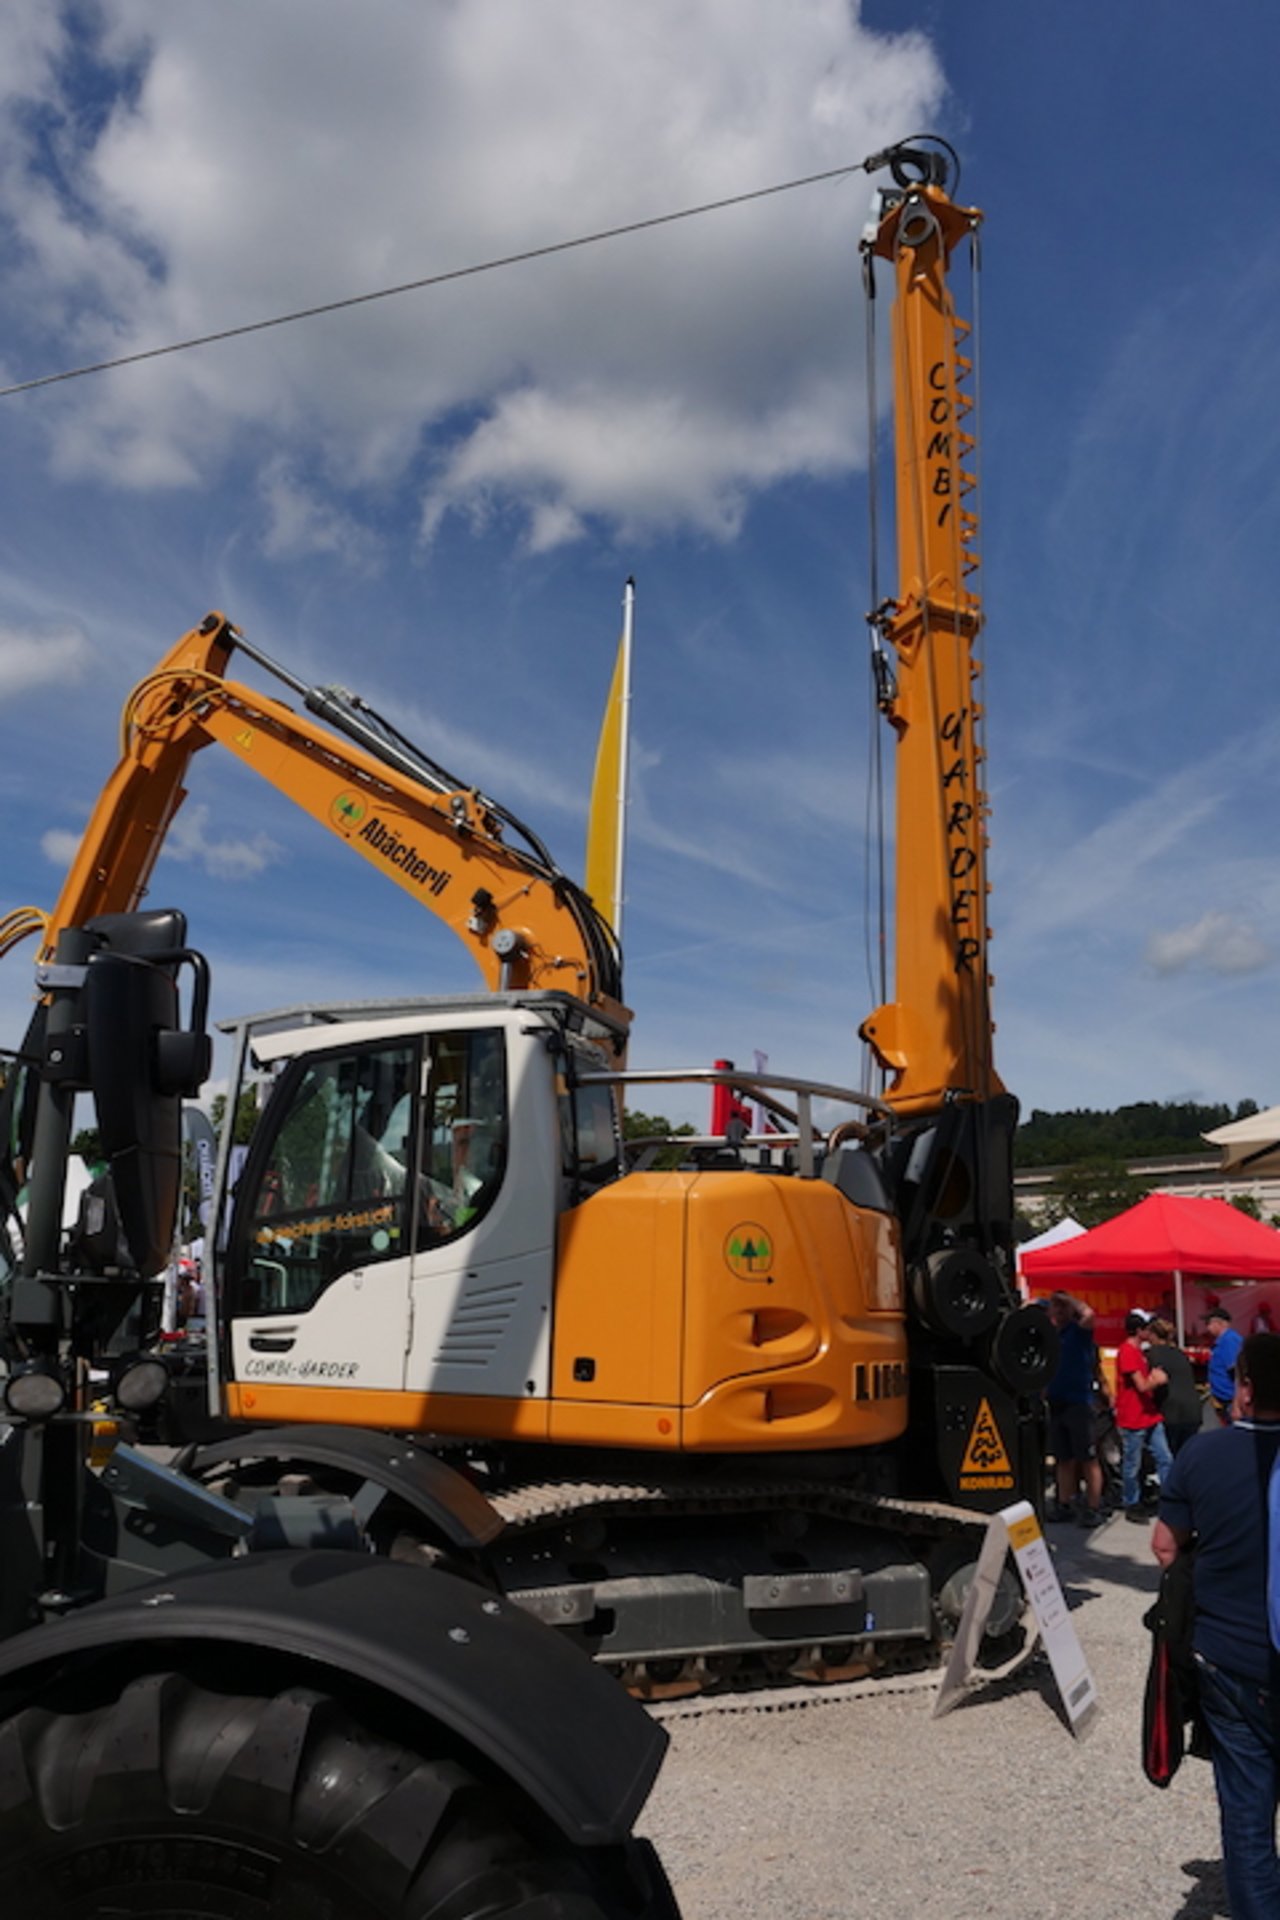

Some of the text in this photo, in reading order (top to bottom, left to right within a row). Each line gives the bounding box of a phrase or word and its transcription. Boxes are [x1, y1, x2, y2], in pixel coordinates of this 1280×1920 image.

[926, 361, 953, 528] COMBI
[359, 817, 452, 897] Abächerli
[940, 707, 980, 974] YARDER
[959, 1476, 1014, 1490] KONRAD
